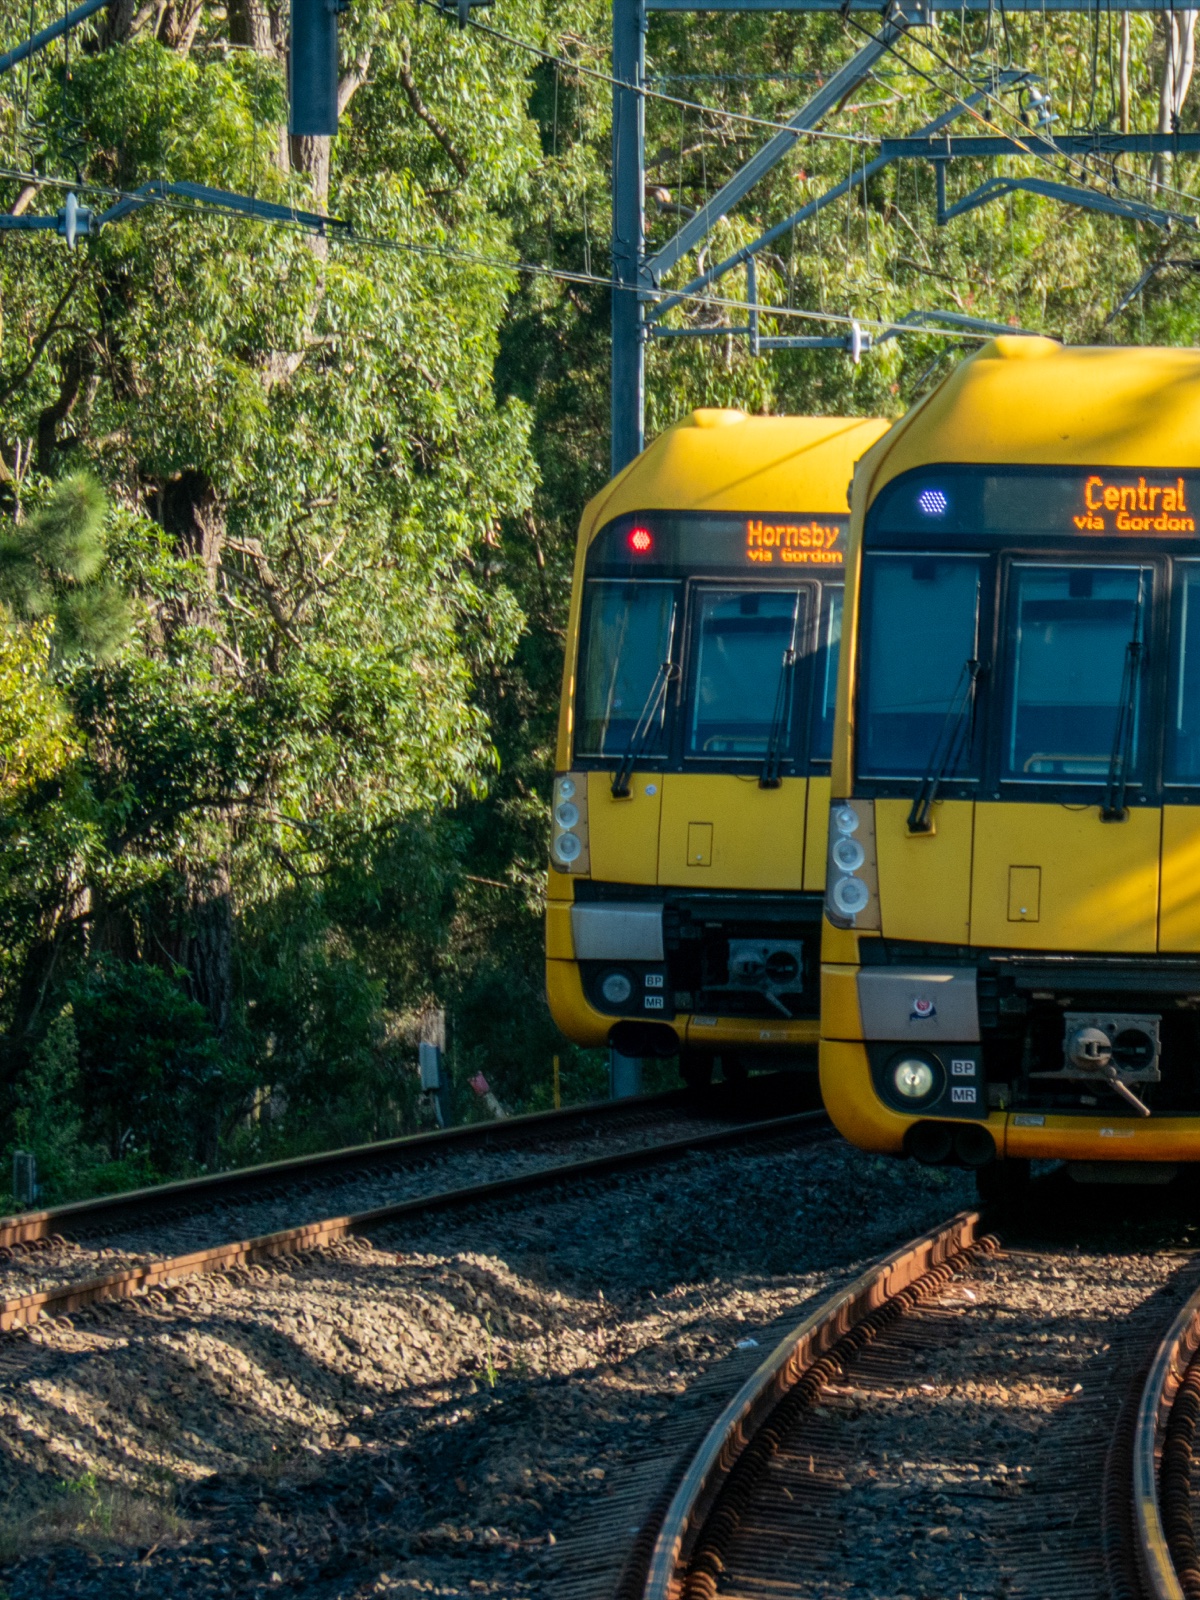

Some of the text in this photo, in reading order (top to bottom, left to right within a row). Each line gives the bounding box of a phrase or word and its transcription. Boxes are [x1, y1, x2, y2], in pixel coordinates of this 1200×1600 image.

[1084, 475, 1187, 512] Central
[1072, 510, 1195, 532] via Gordon
[746, 519, 840, 549] Hornsby
[746, 547, 843, 563] via Gordon
[646, 976, 662, 986] BP
[645, 998, 662, 1008] MR
[953, 1061, 974, 1074] BP
[953, 1089, 975, 1101] MR
